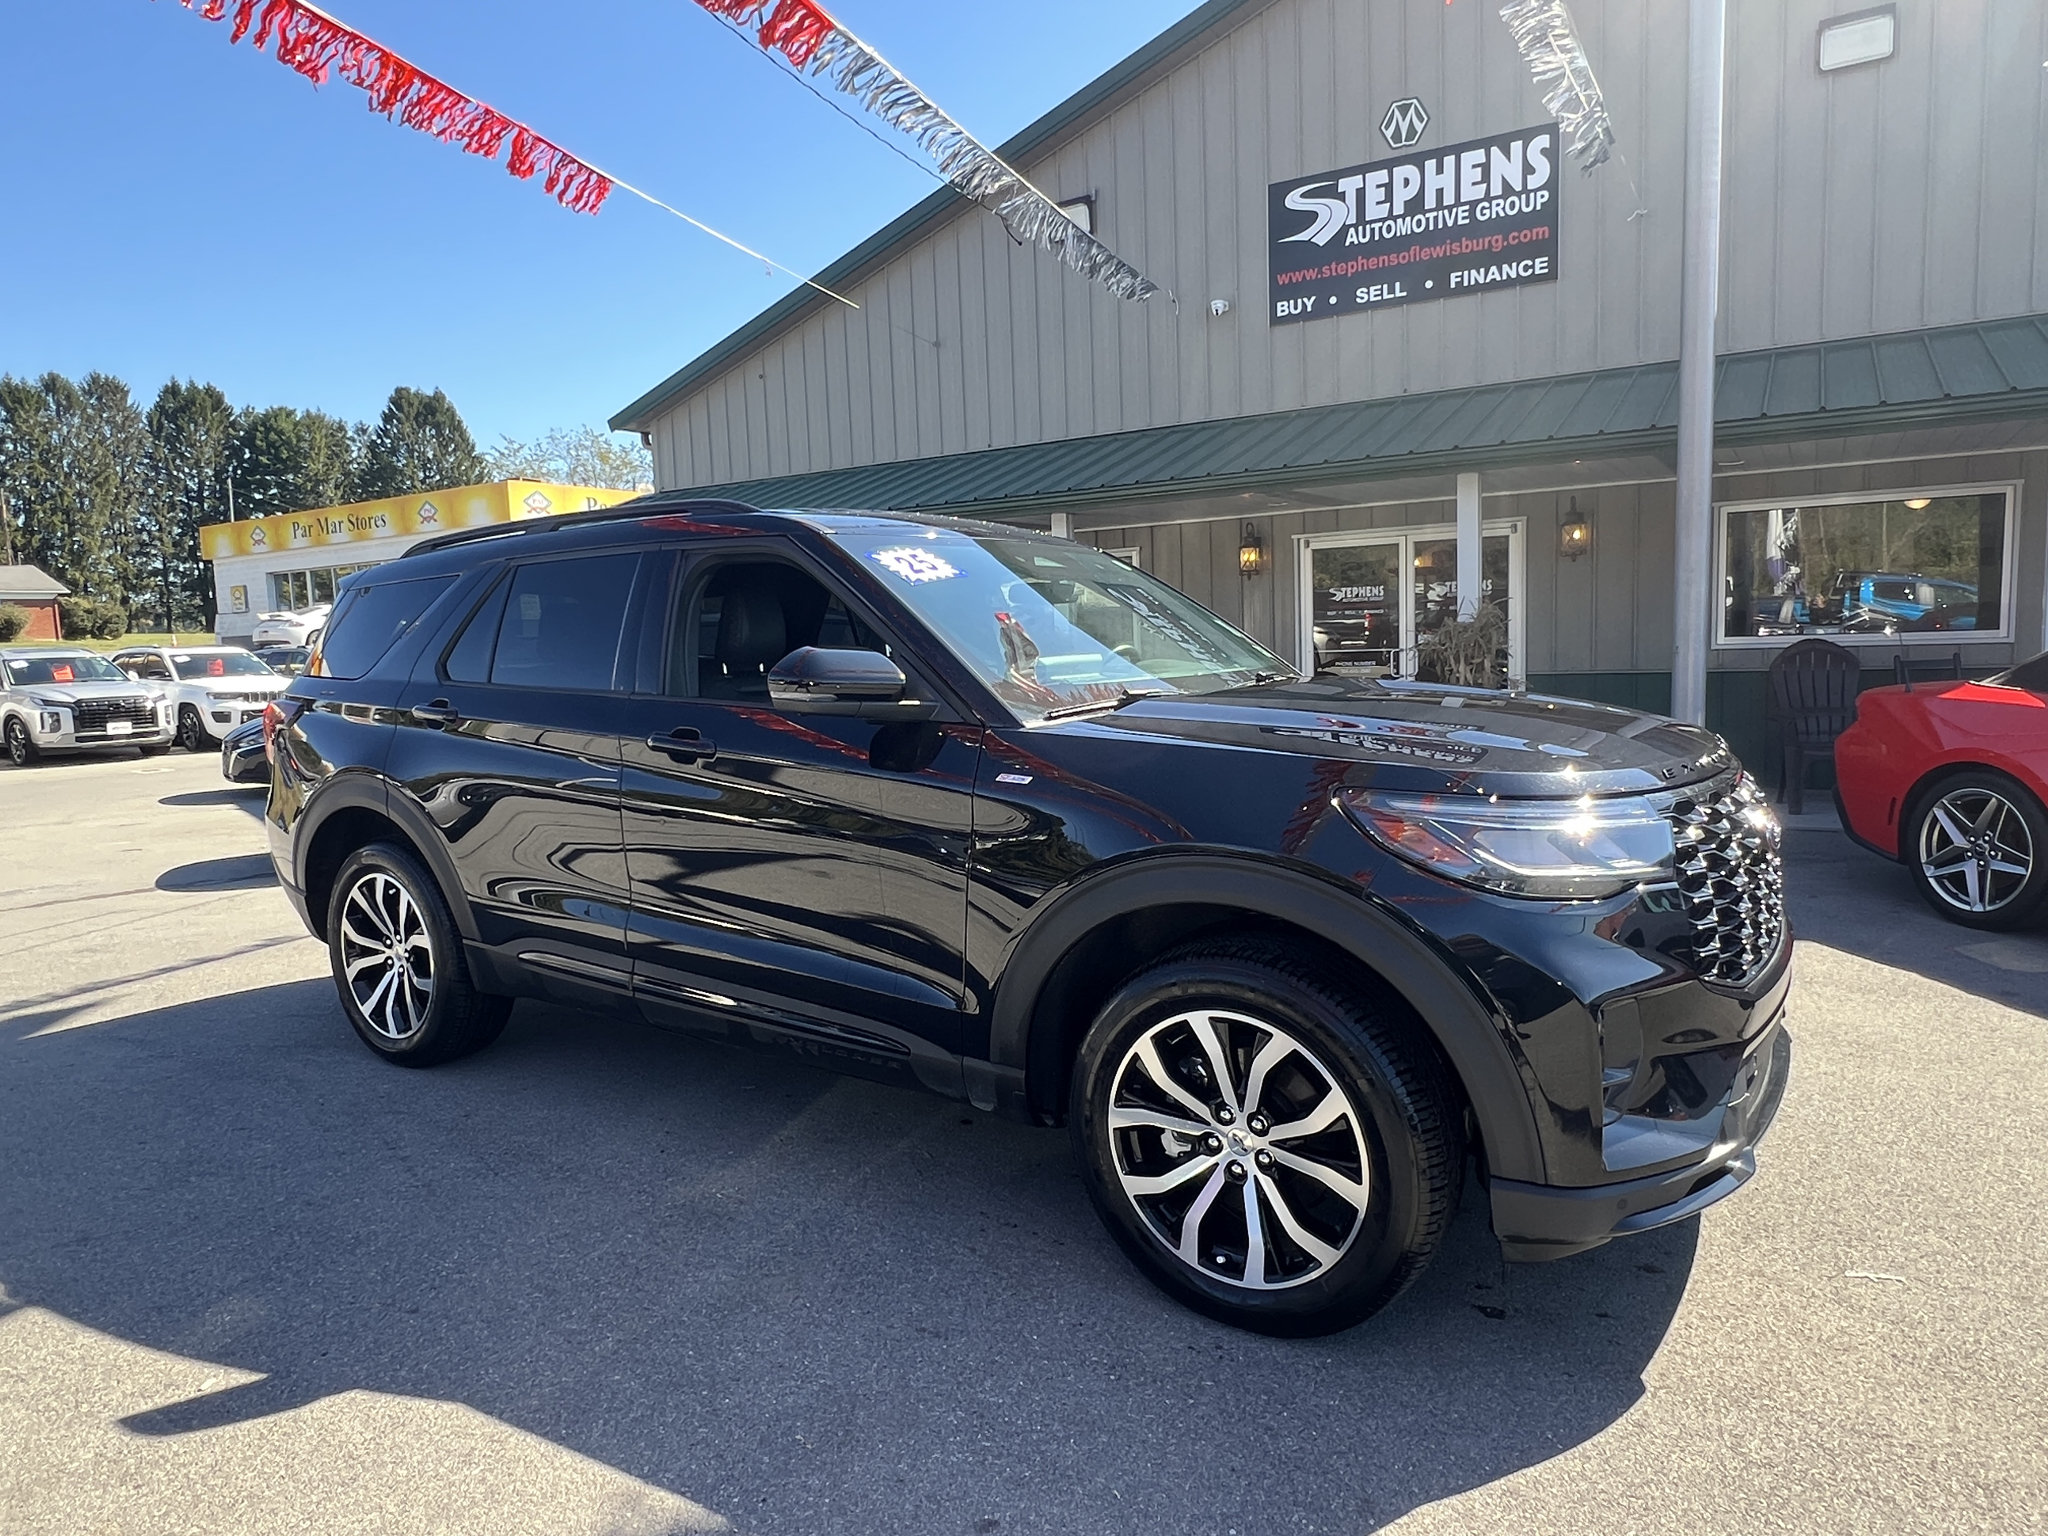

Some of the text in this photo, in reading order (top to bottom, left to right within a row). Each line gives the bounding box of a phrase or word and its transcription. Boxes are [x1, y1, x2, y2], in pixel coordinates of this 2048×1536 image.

[1277, 134, 1551, 247] STEPHENS
[1344, 189, 1550, 247] AUTOMOTIVE GROUP
[1276, 225, 1550, 286] www.stephensoflewisburg.com
[1276, 256, 1549, 318] BUY SELL FINANCE
[291, 512, 387, 540] Par Mar Stores
[1328, 585, 1385, 602] STEPHENS
